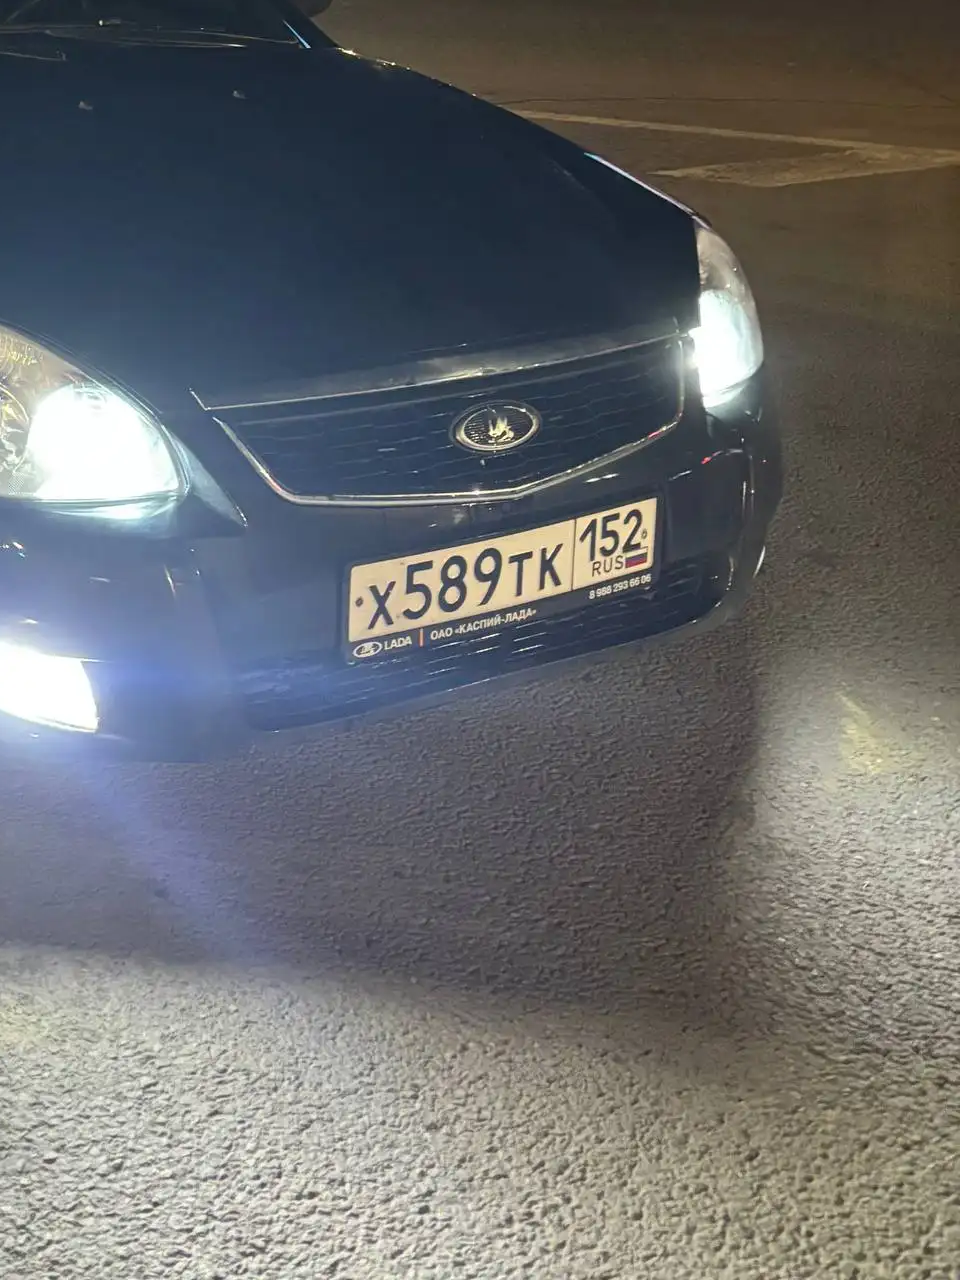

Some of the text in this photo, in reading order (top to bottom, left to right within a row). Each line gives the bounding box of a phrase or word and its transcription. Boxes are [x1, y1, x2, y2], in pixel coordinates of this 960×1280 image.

[579, 509, 643, 562] 152
[592, 555, 624, 577] RUS
[430, 626, 453, 641] ОАО
[384, 636, 413, 651] LADA
